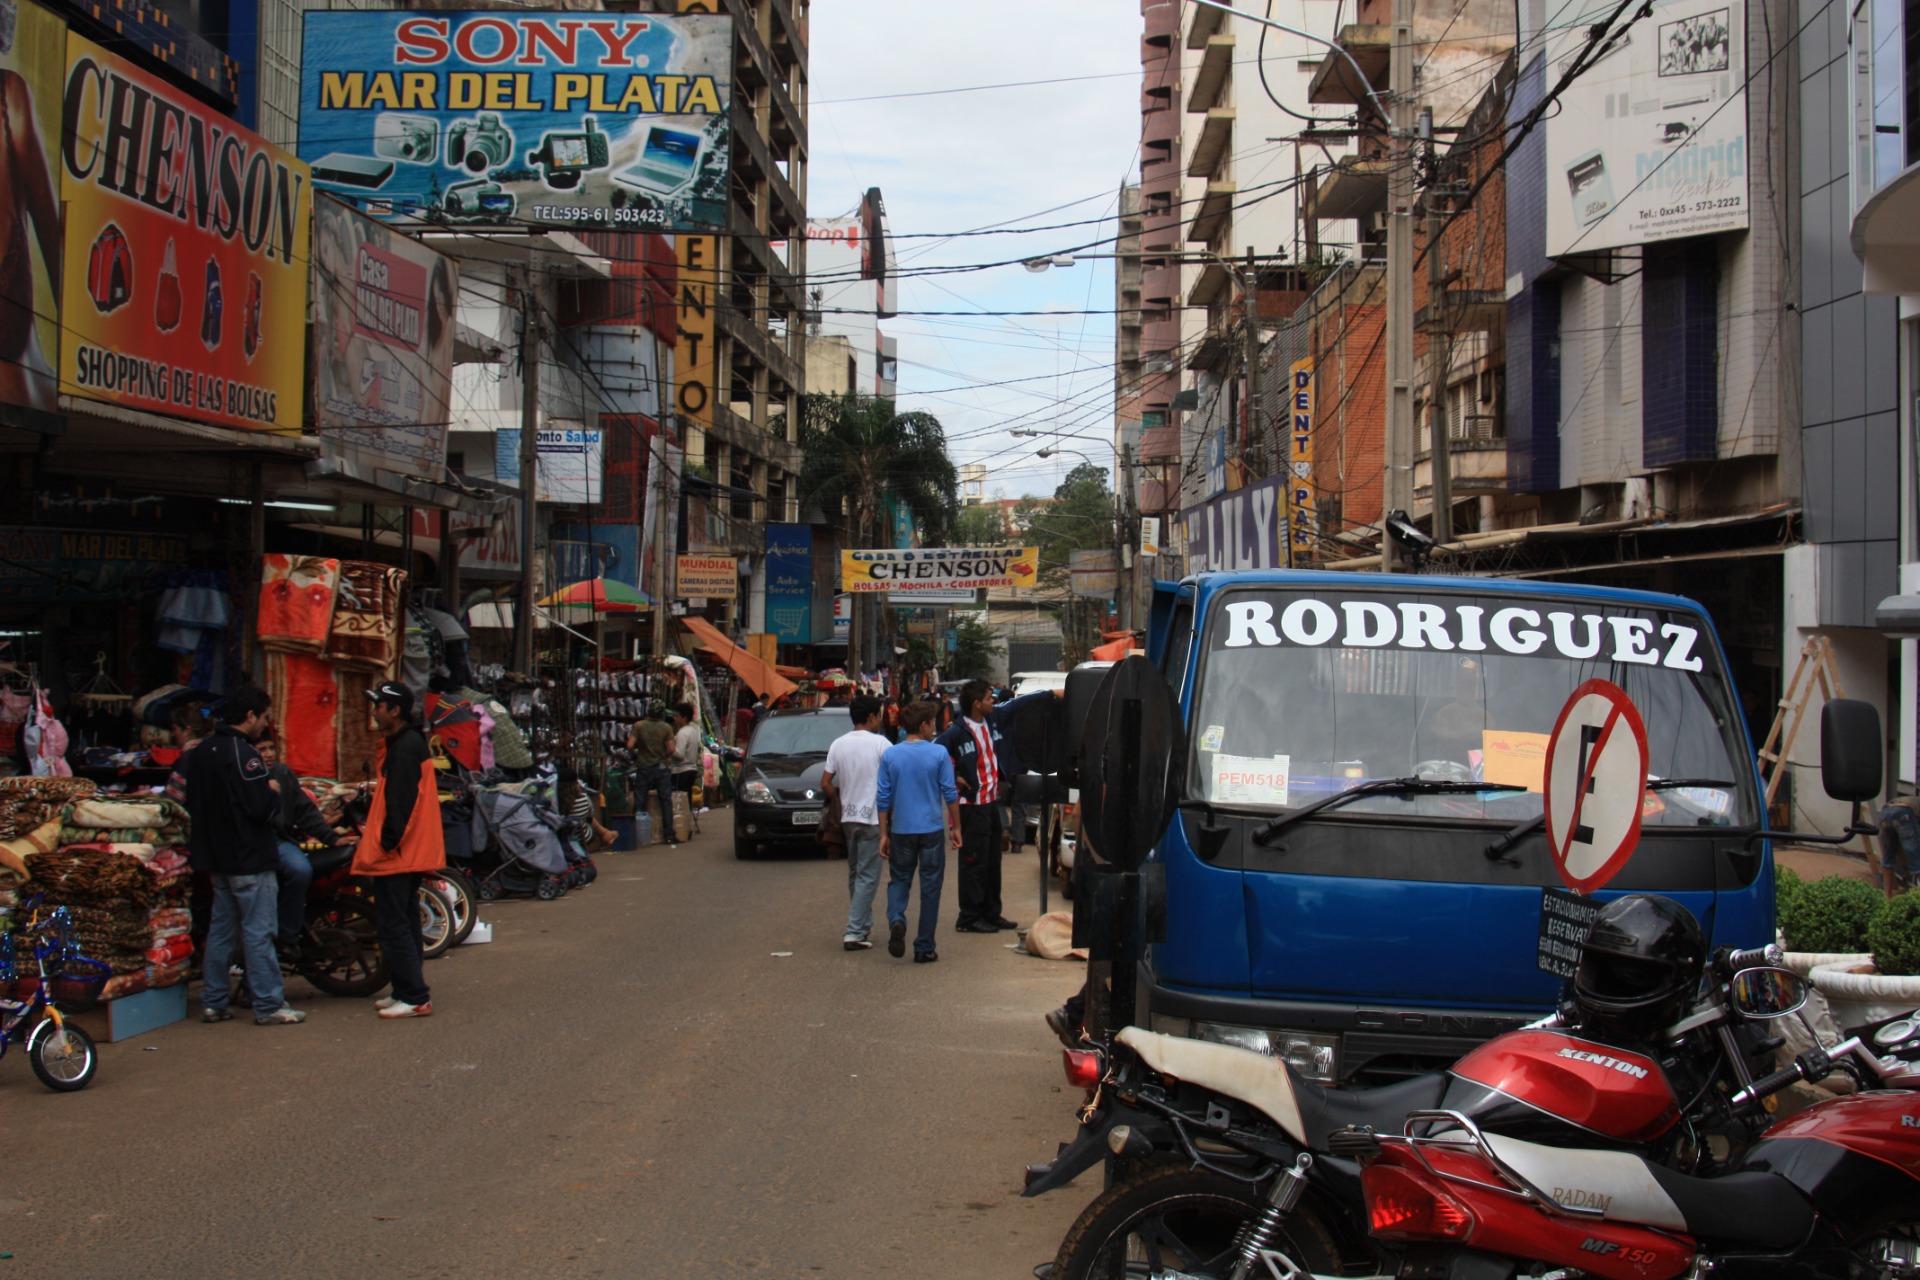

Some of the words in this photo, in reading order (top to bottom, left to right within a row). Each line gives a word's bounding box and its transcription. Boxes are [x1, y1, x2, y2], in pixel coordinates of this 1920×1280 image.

[394, 18, 649, 66] SONY
[320, 71, 436, 111] MAR
[447, 72, 541, 111] DEL
[552, 73, 722, 113] PLATA
[63, 57, 302, 266] CHENSON
[1635, 135, 1744, 192] Madrid
[614, 207, 665, 223] 503423
[1639, 210, 1657, 220] Tel.:
[1660, 204, 1686, 216] 0xx45
[1696, 196, 1741, 212] 573-2222
[360, 247, 389, 291] Casa
[357, 285, 377, 331] MAR
[378, 295, 393, 334] DEL
[395, 301, 420, 346] PLATA
[77, 345, 168, 404] SHOPPING
[172, 368, 194, 407] DE
[197, 374, 222, 412] LAS
[227, 381, 277, 423] BOLSAS
[1295, 371, 1310, 454] DENT
[566, 429, 599, 443] Salud
[1206, 486, 1275, 569] LILY
[61, 534, 100, 560] MAR
[104, 535, 133, 560] DEL
[137, 536, 188, 562] PLATA
[852, 551, 897, 561] Casa
[680, 559, 735, 570] MUNDIAL
[868, 559, 1009, 580] CHENSON
[768, 585, 806, 594] Service
[777, 575, 799, 585] Auto
[854, 581, 890, 591] BOLSAS
[898, 581, 943, 590] MOCHILA
[950, 578, 1013, 589] COBERTORES
[1224, 599, 1703, 672] RODRIGUEZ
[1218, 772, 1285, 787] PEM518
[1557, 1047, 1648, 1079] KENTON
[1553, 1187, 1613, 1211] RADAM
[1580, 1237, 1657, 1264] MF150
